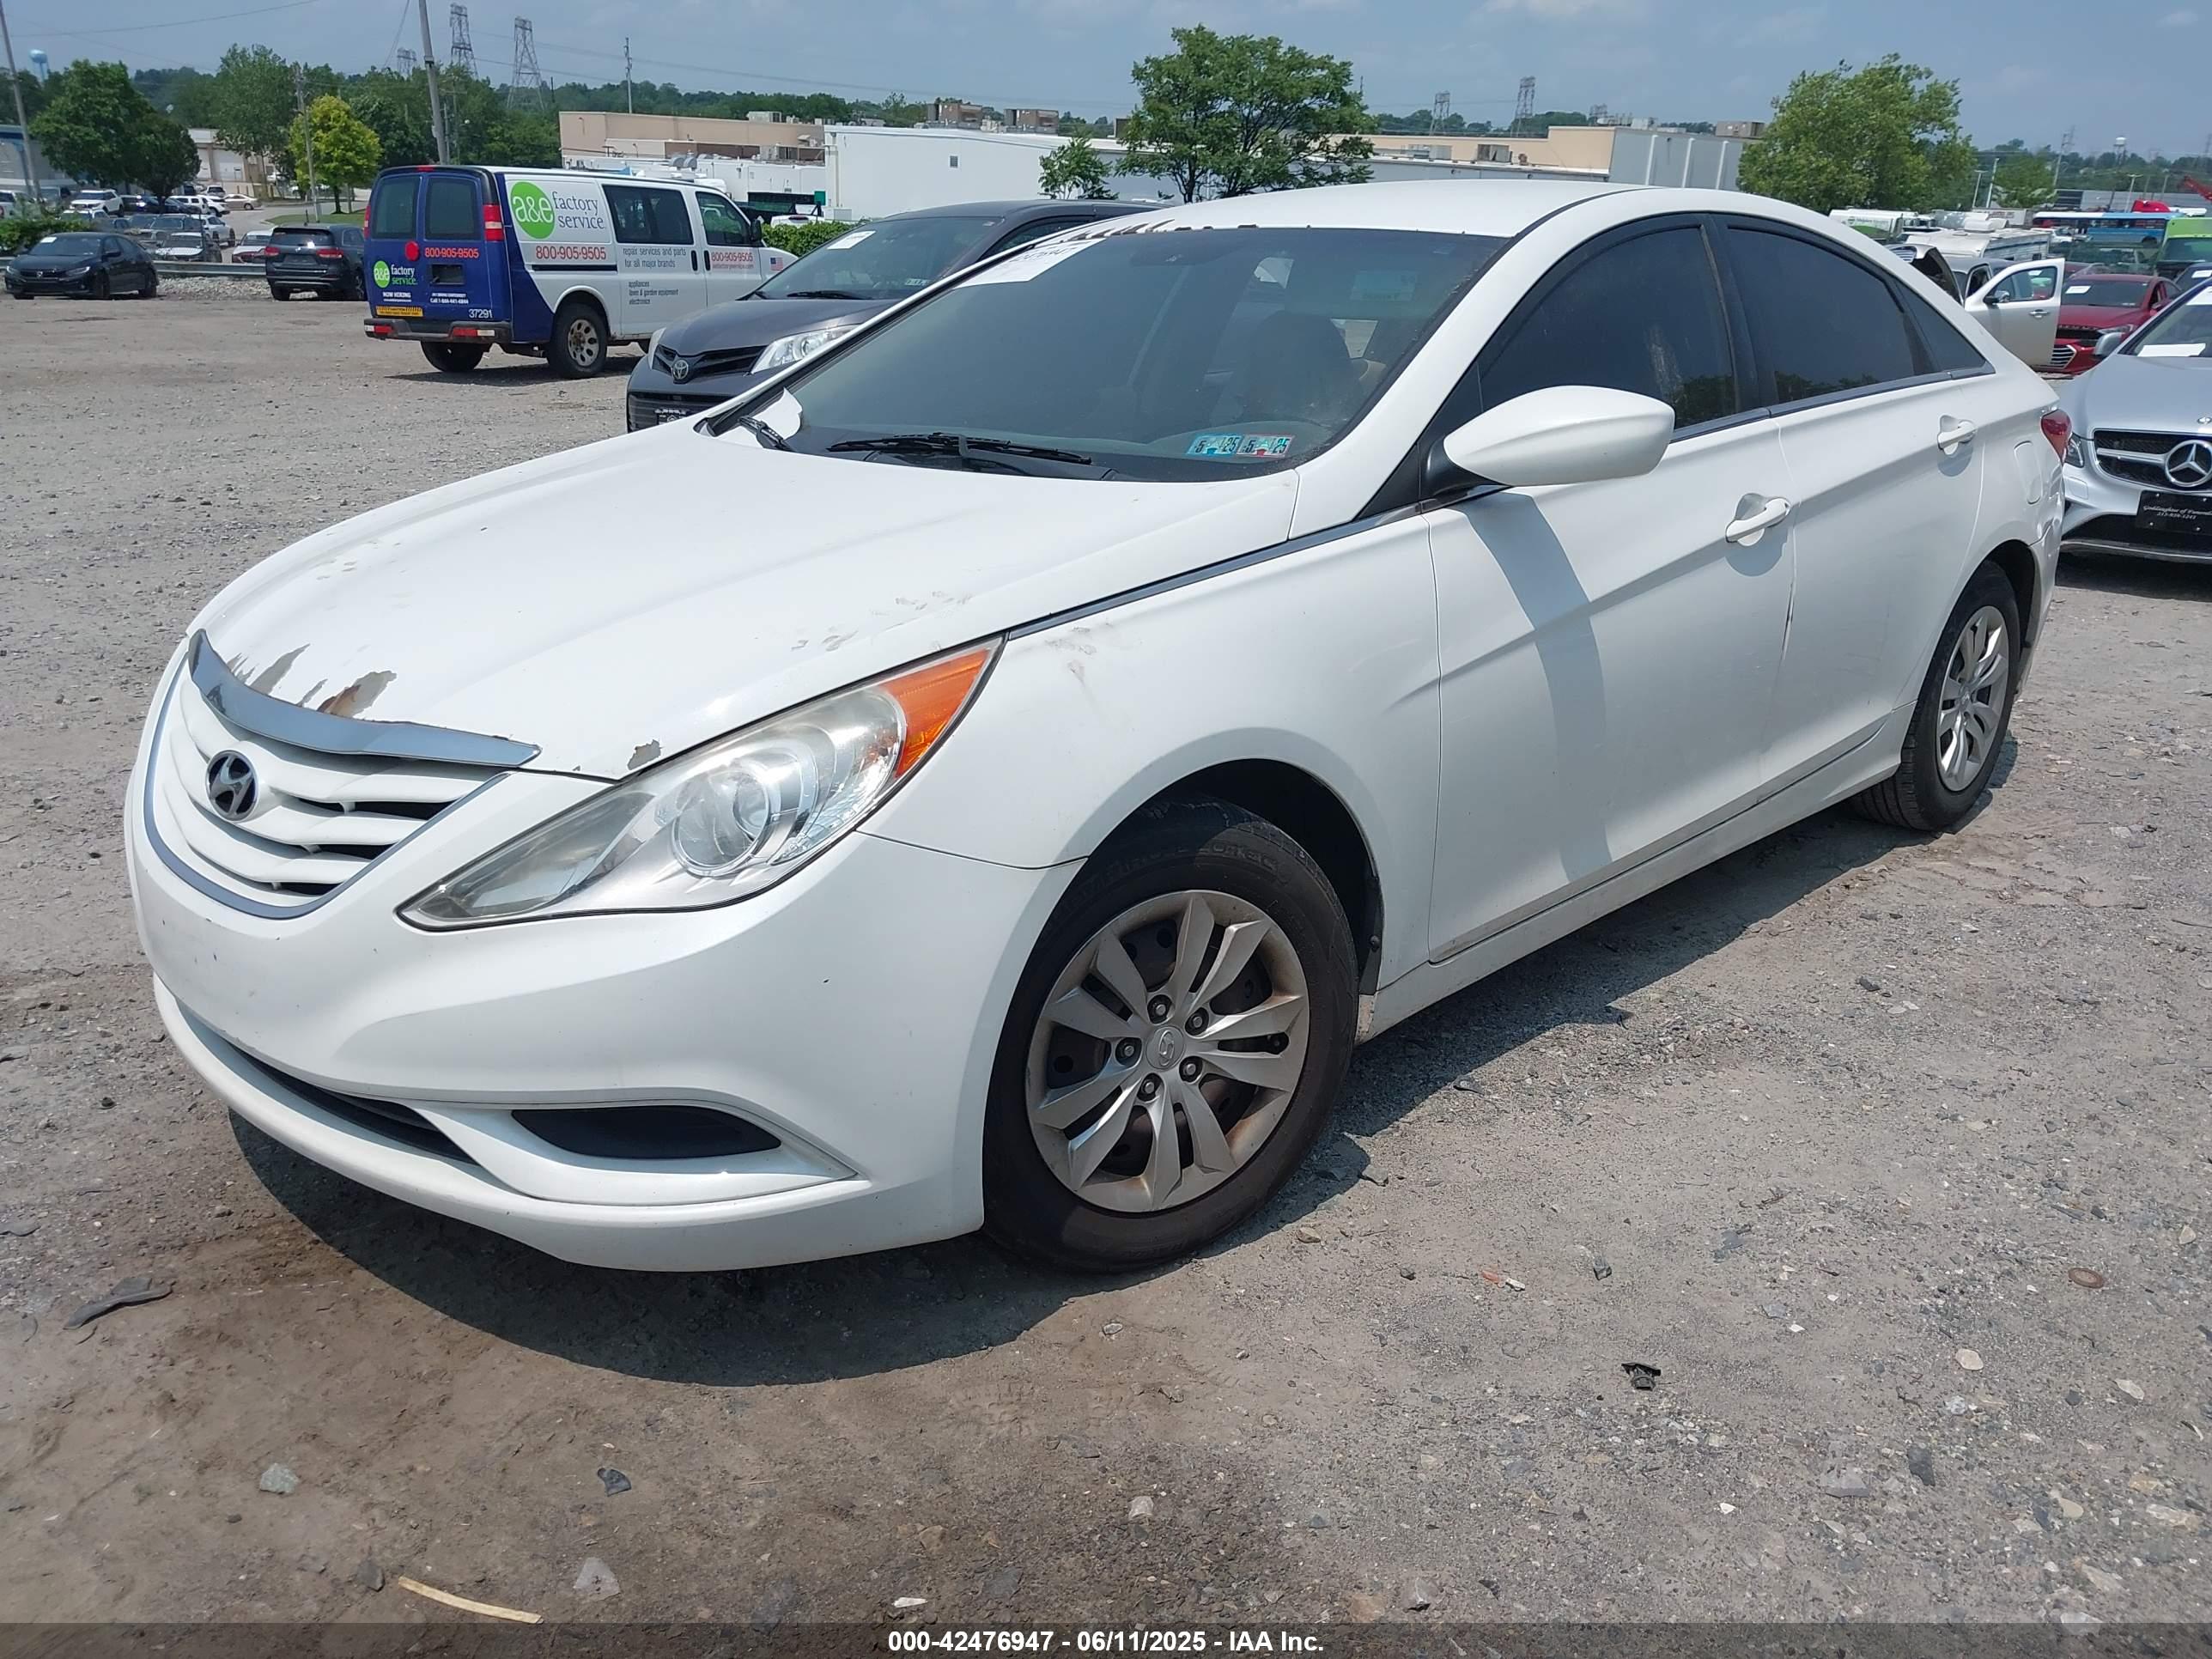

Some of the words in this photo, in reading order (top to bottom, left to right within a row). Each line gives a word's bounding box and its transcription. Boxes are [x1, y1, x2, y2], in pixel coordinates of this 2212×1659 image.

[513, 196, 554, 223] a&e
[552, 191, 599, 216] factory
[623, 247, 638, 258] repair
[639, 247, 661, 257] services
[662, 248, 672, 257] and
[673, 248, 687, 258] parts
[391, 264, 415, 276] factory
[642, 259, 657, 270] major
[657, 259, 676, 269] brands
[468, 308, 493, 319] 37291
[1223, 436, 1238, 453] 25
[1273, 438, 1291, 453] 25
